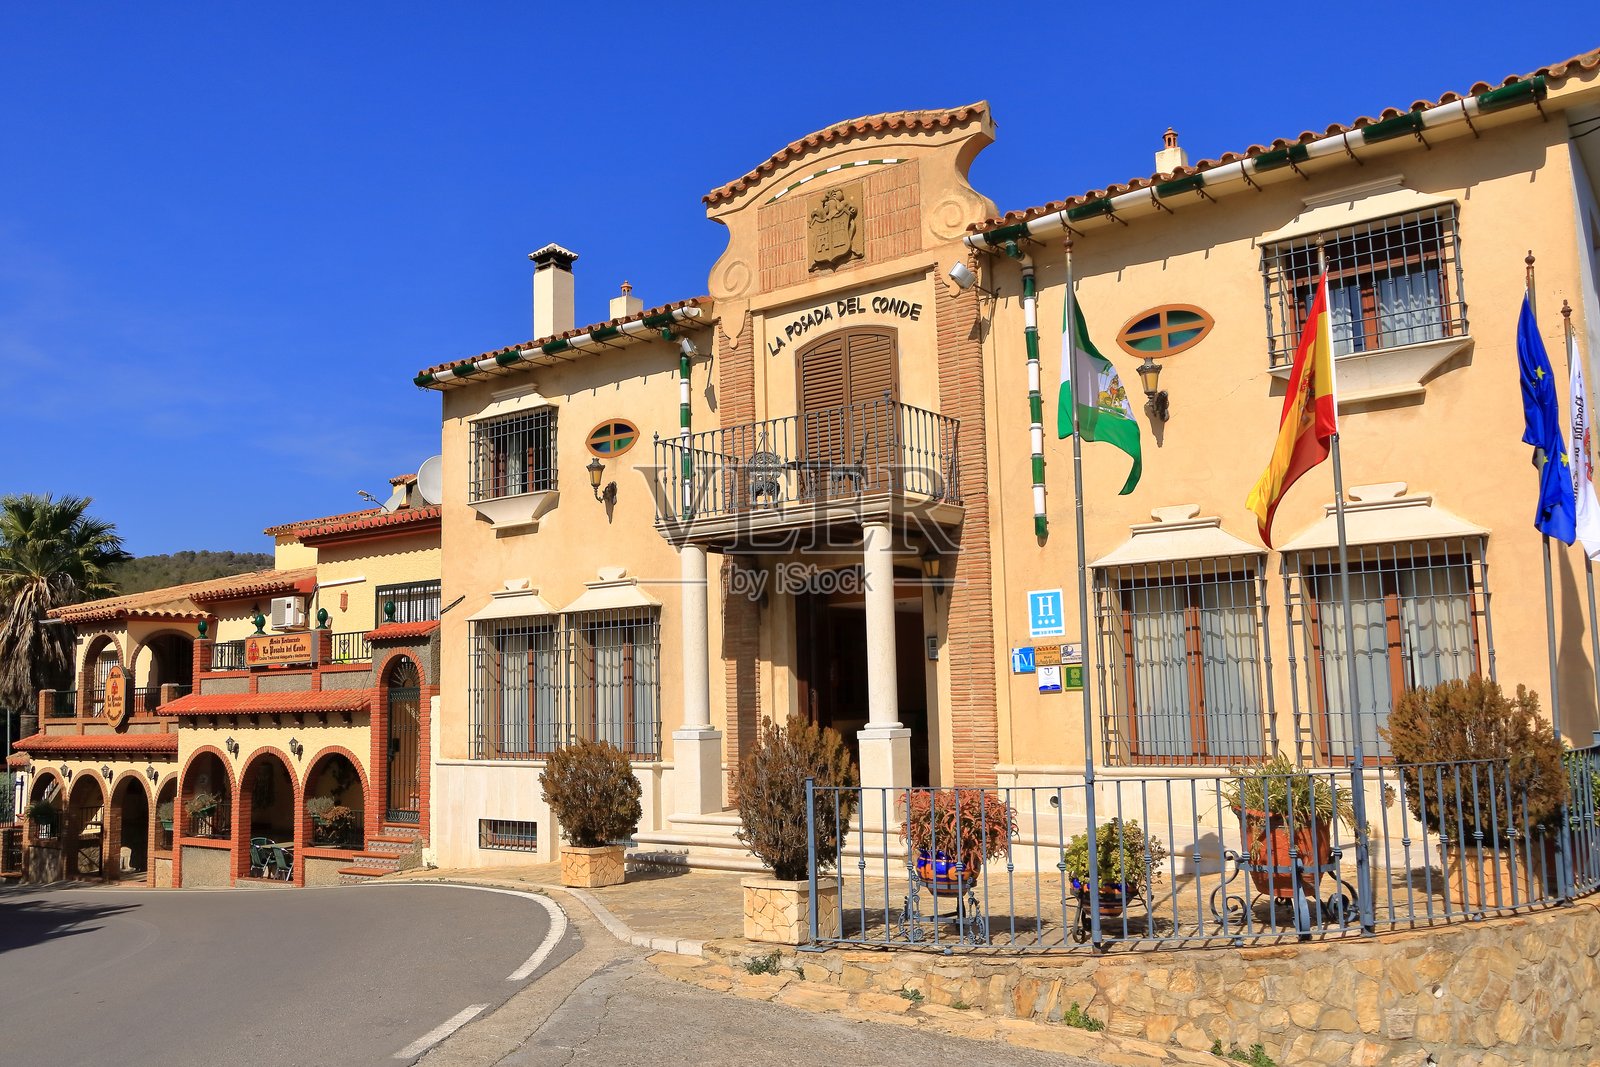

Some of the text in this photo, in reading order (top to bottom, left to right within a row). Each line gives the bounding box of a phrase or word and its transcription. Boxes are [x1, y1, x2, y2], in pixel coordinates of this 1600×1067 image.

[768, 296, 922, 357] LA POSADA DEL CONDE
[1037, 595, 1055, 617] H
